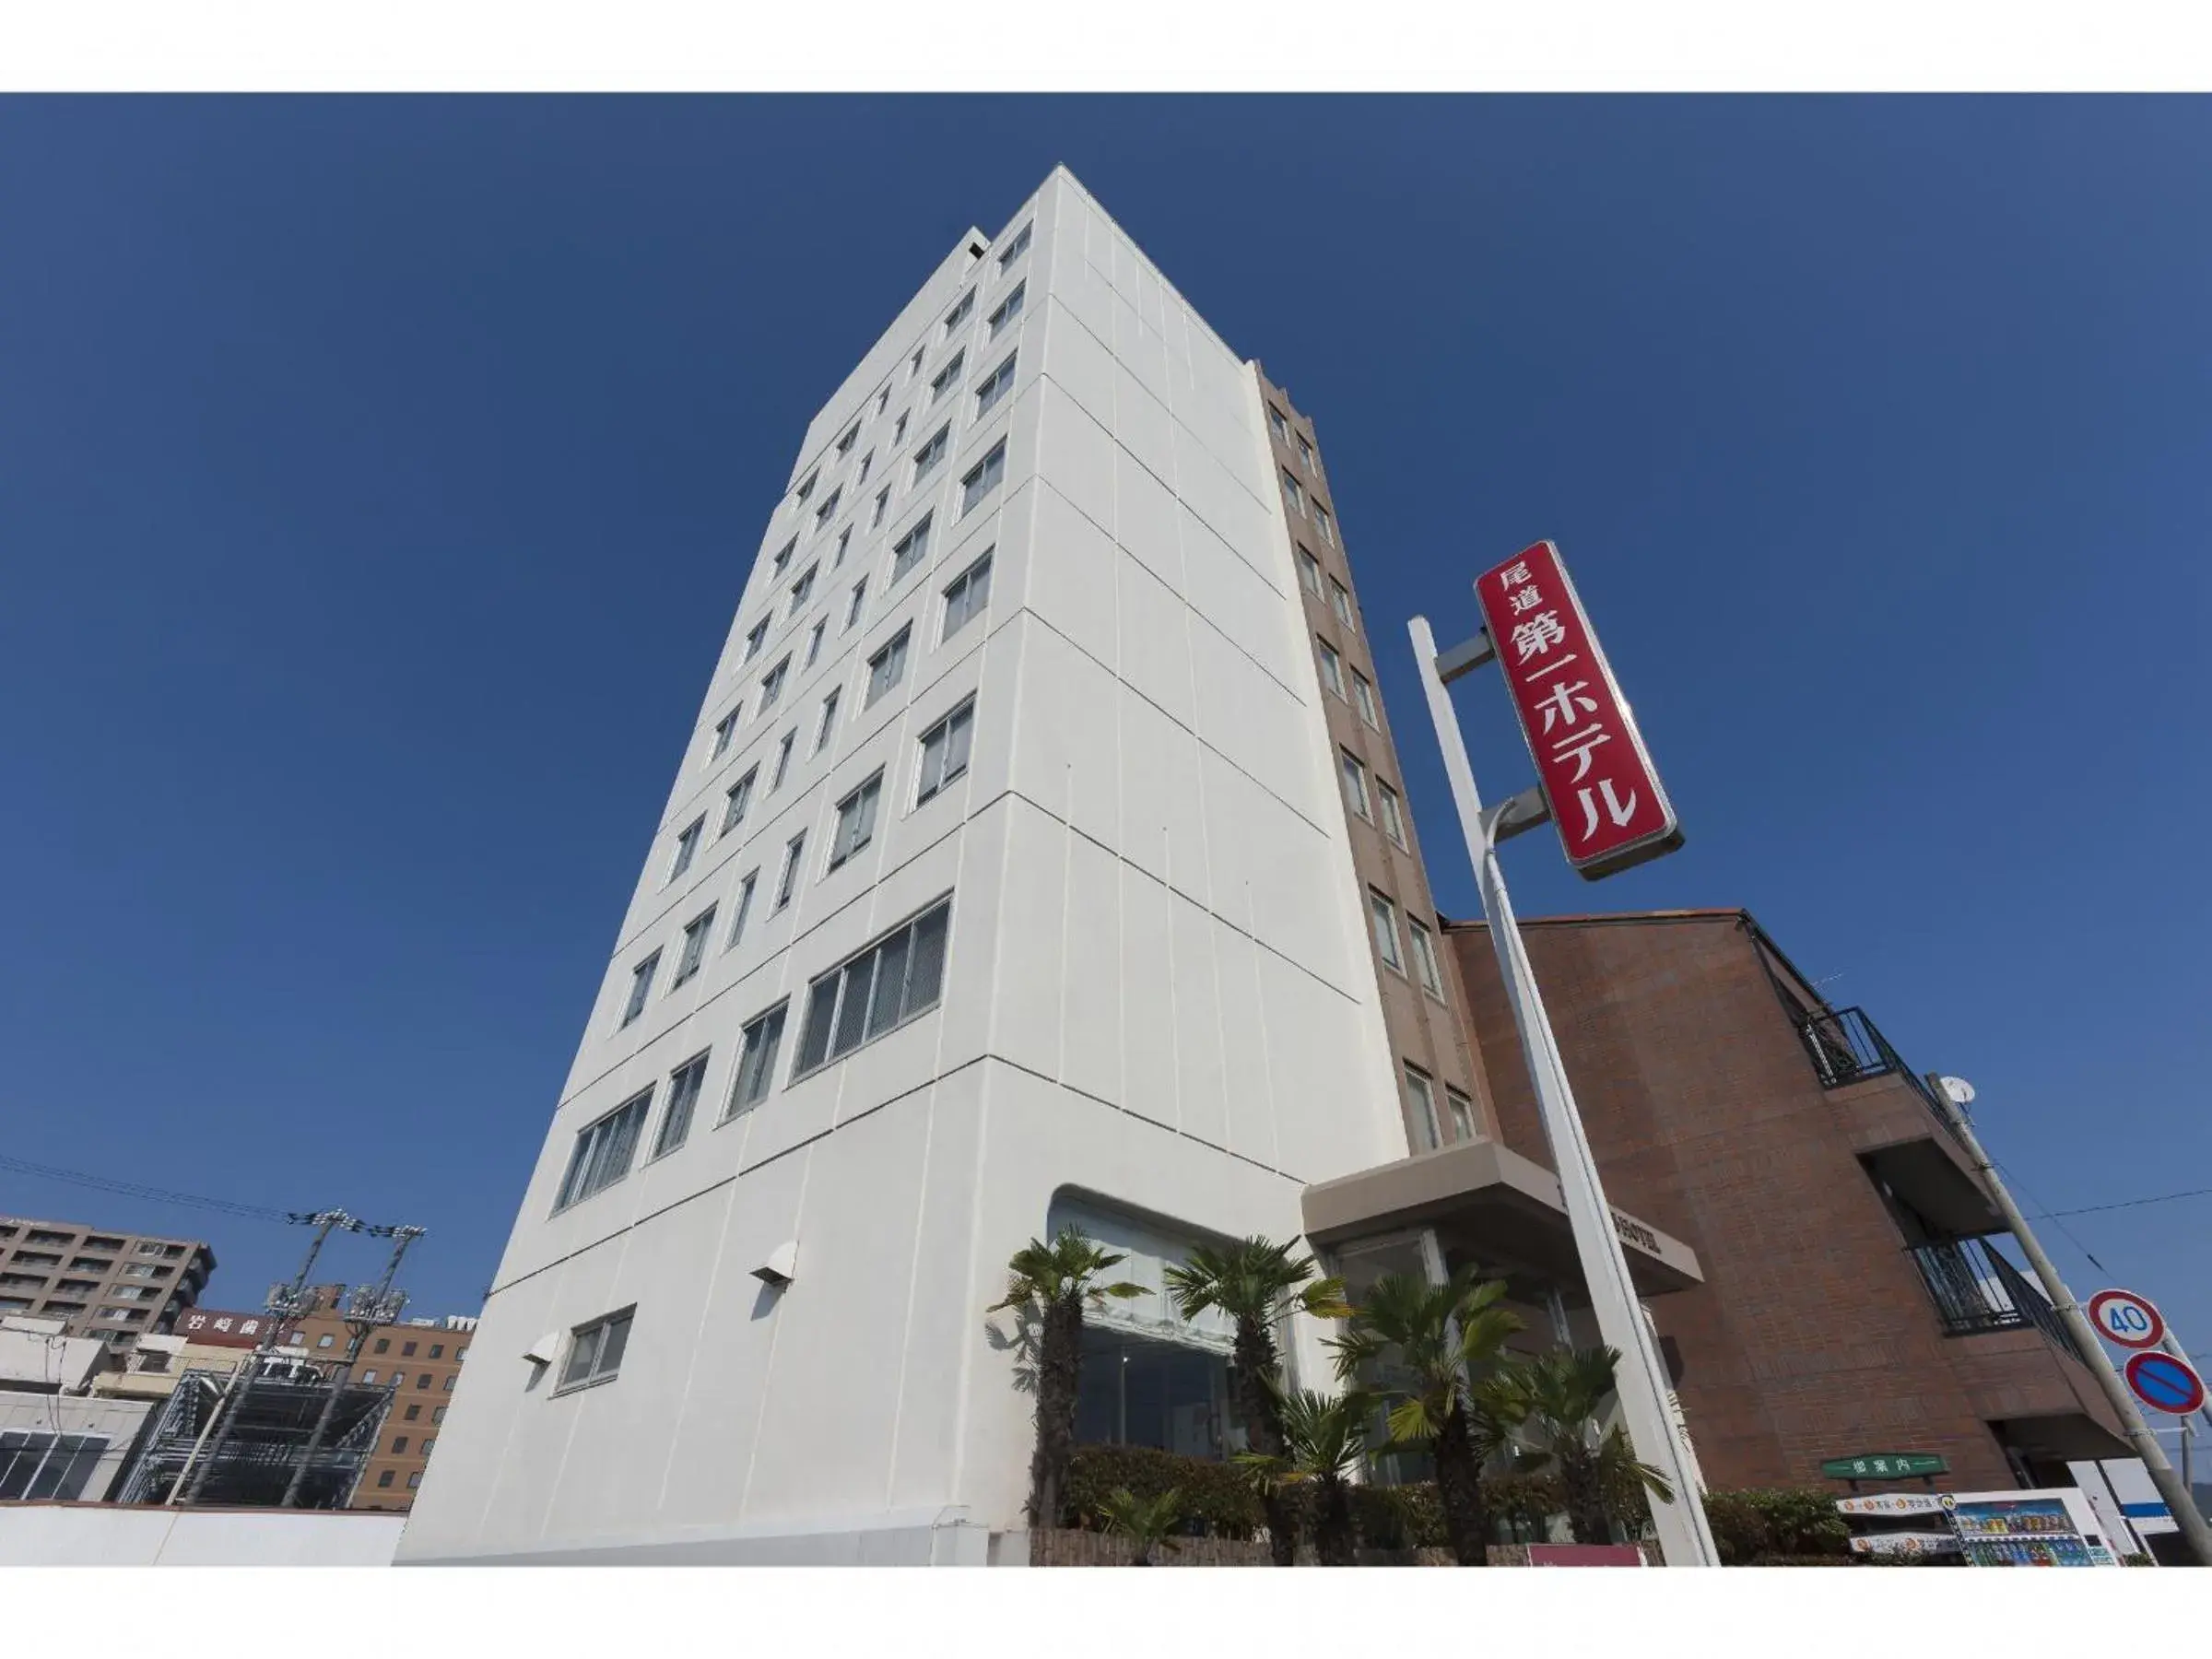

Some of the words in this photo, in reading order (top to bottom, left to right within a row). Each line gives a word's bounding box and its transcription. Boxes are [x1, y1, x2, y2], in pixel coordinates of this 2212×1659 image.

[1500, 560, 1637, 842] 尾道第一ホテル
[2110, 1305, 2147, 1333] 40
